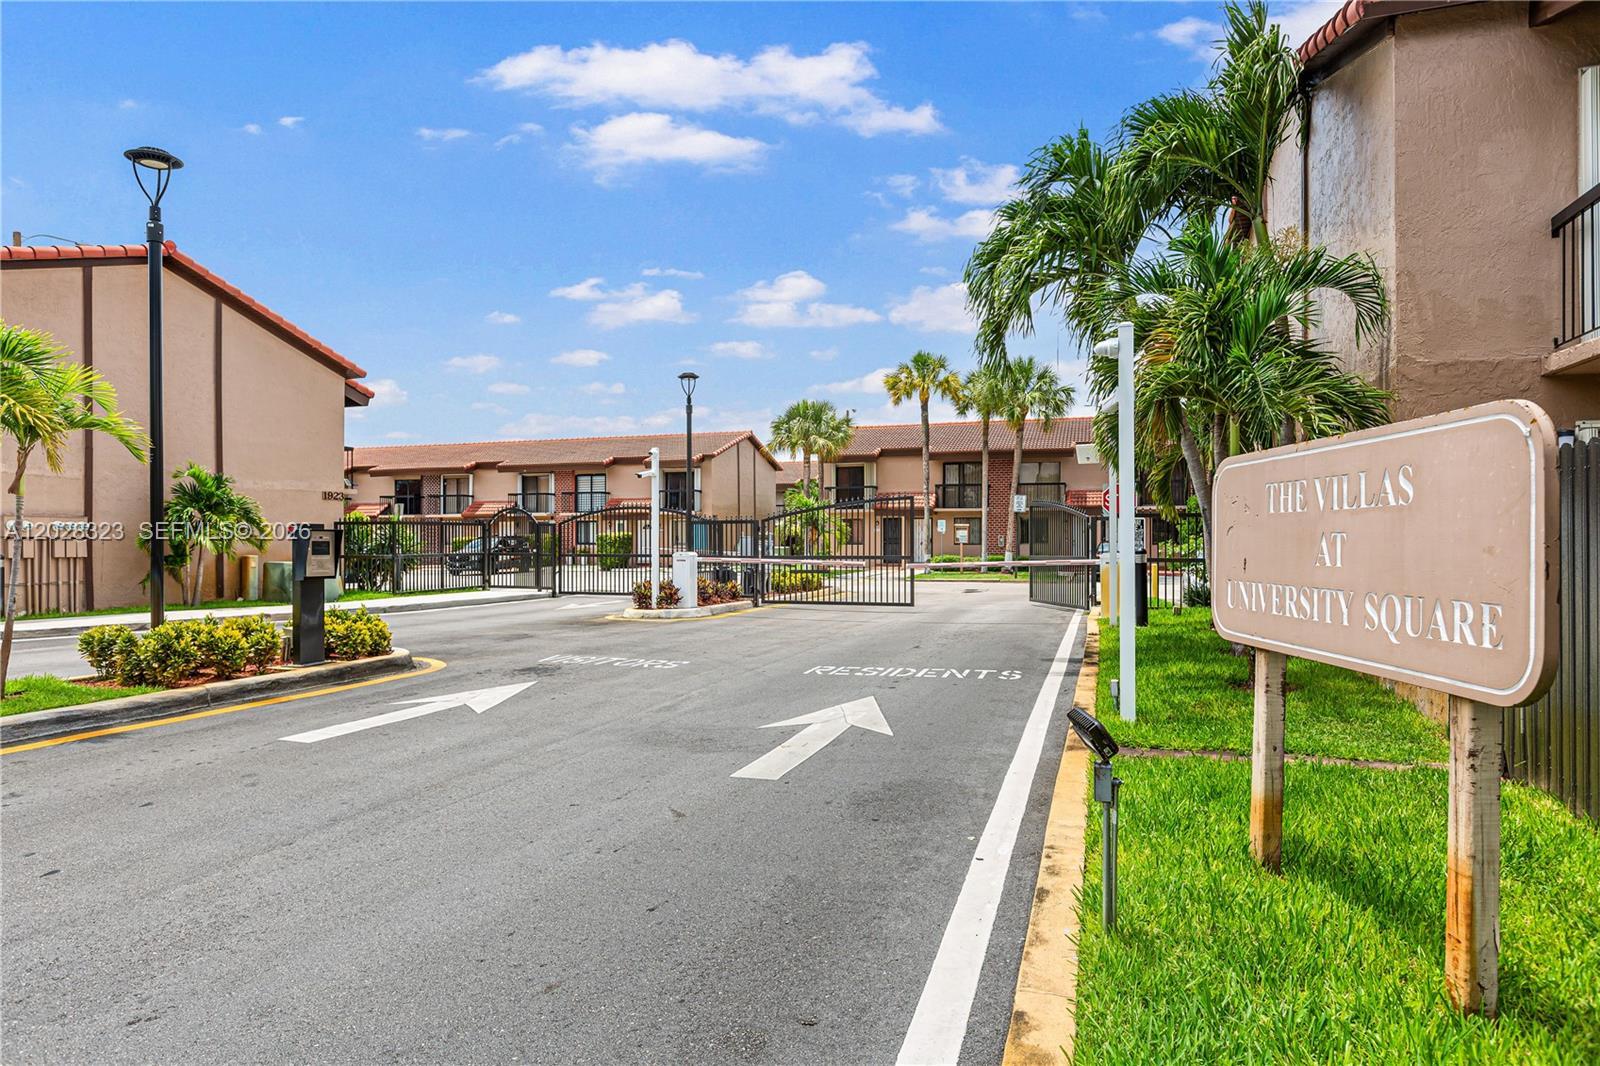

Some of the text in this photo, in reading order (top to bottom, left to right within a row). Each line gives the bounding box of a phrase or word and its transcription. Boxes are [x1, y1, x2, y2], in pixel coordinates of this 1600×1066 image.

[322, 491, 345, 501] 1923
[1265, 464, 1415, 513] THE VILLAS
[1315, 531, 1347, 567] AT
[1226, 580, 1504, 650] UNIVERSITY SQUARE
[538, 654, 690, 669] VISITORS
[803, 665, 1023, 680] RESIDENTS
